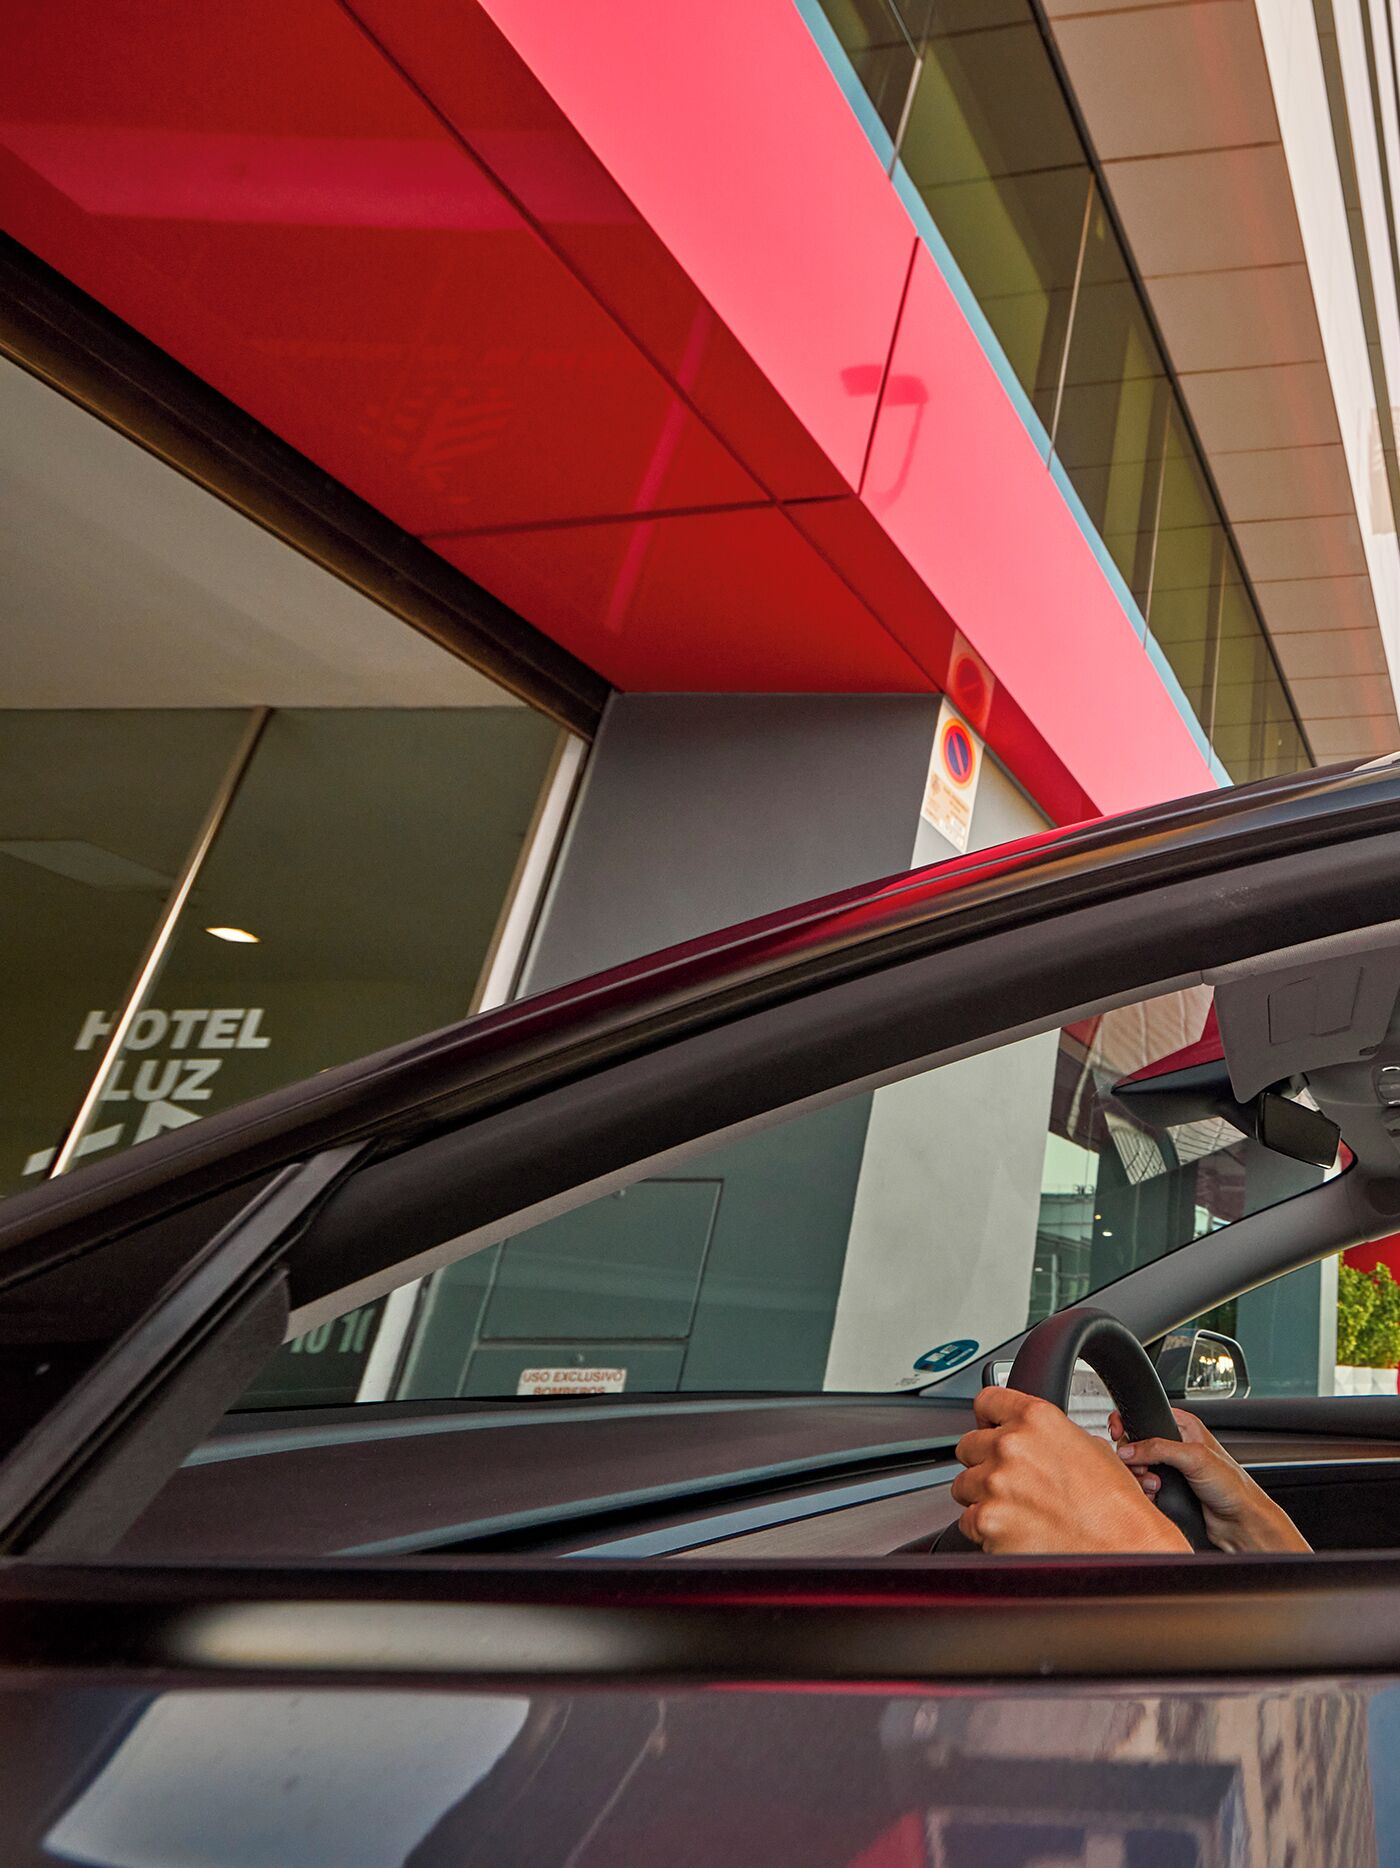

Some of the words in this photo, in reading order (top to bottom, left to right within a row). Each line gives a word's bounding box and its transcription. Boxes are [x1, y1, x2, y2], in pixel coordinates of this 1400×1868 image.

[75, 1008, 271, 1050] HOTEL
[99, 1059, 222, 1101] LUZ
[523, 1371, 549, 1382] USO
[553, 1371, 623, 1382] EXCLUSIVO
